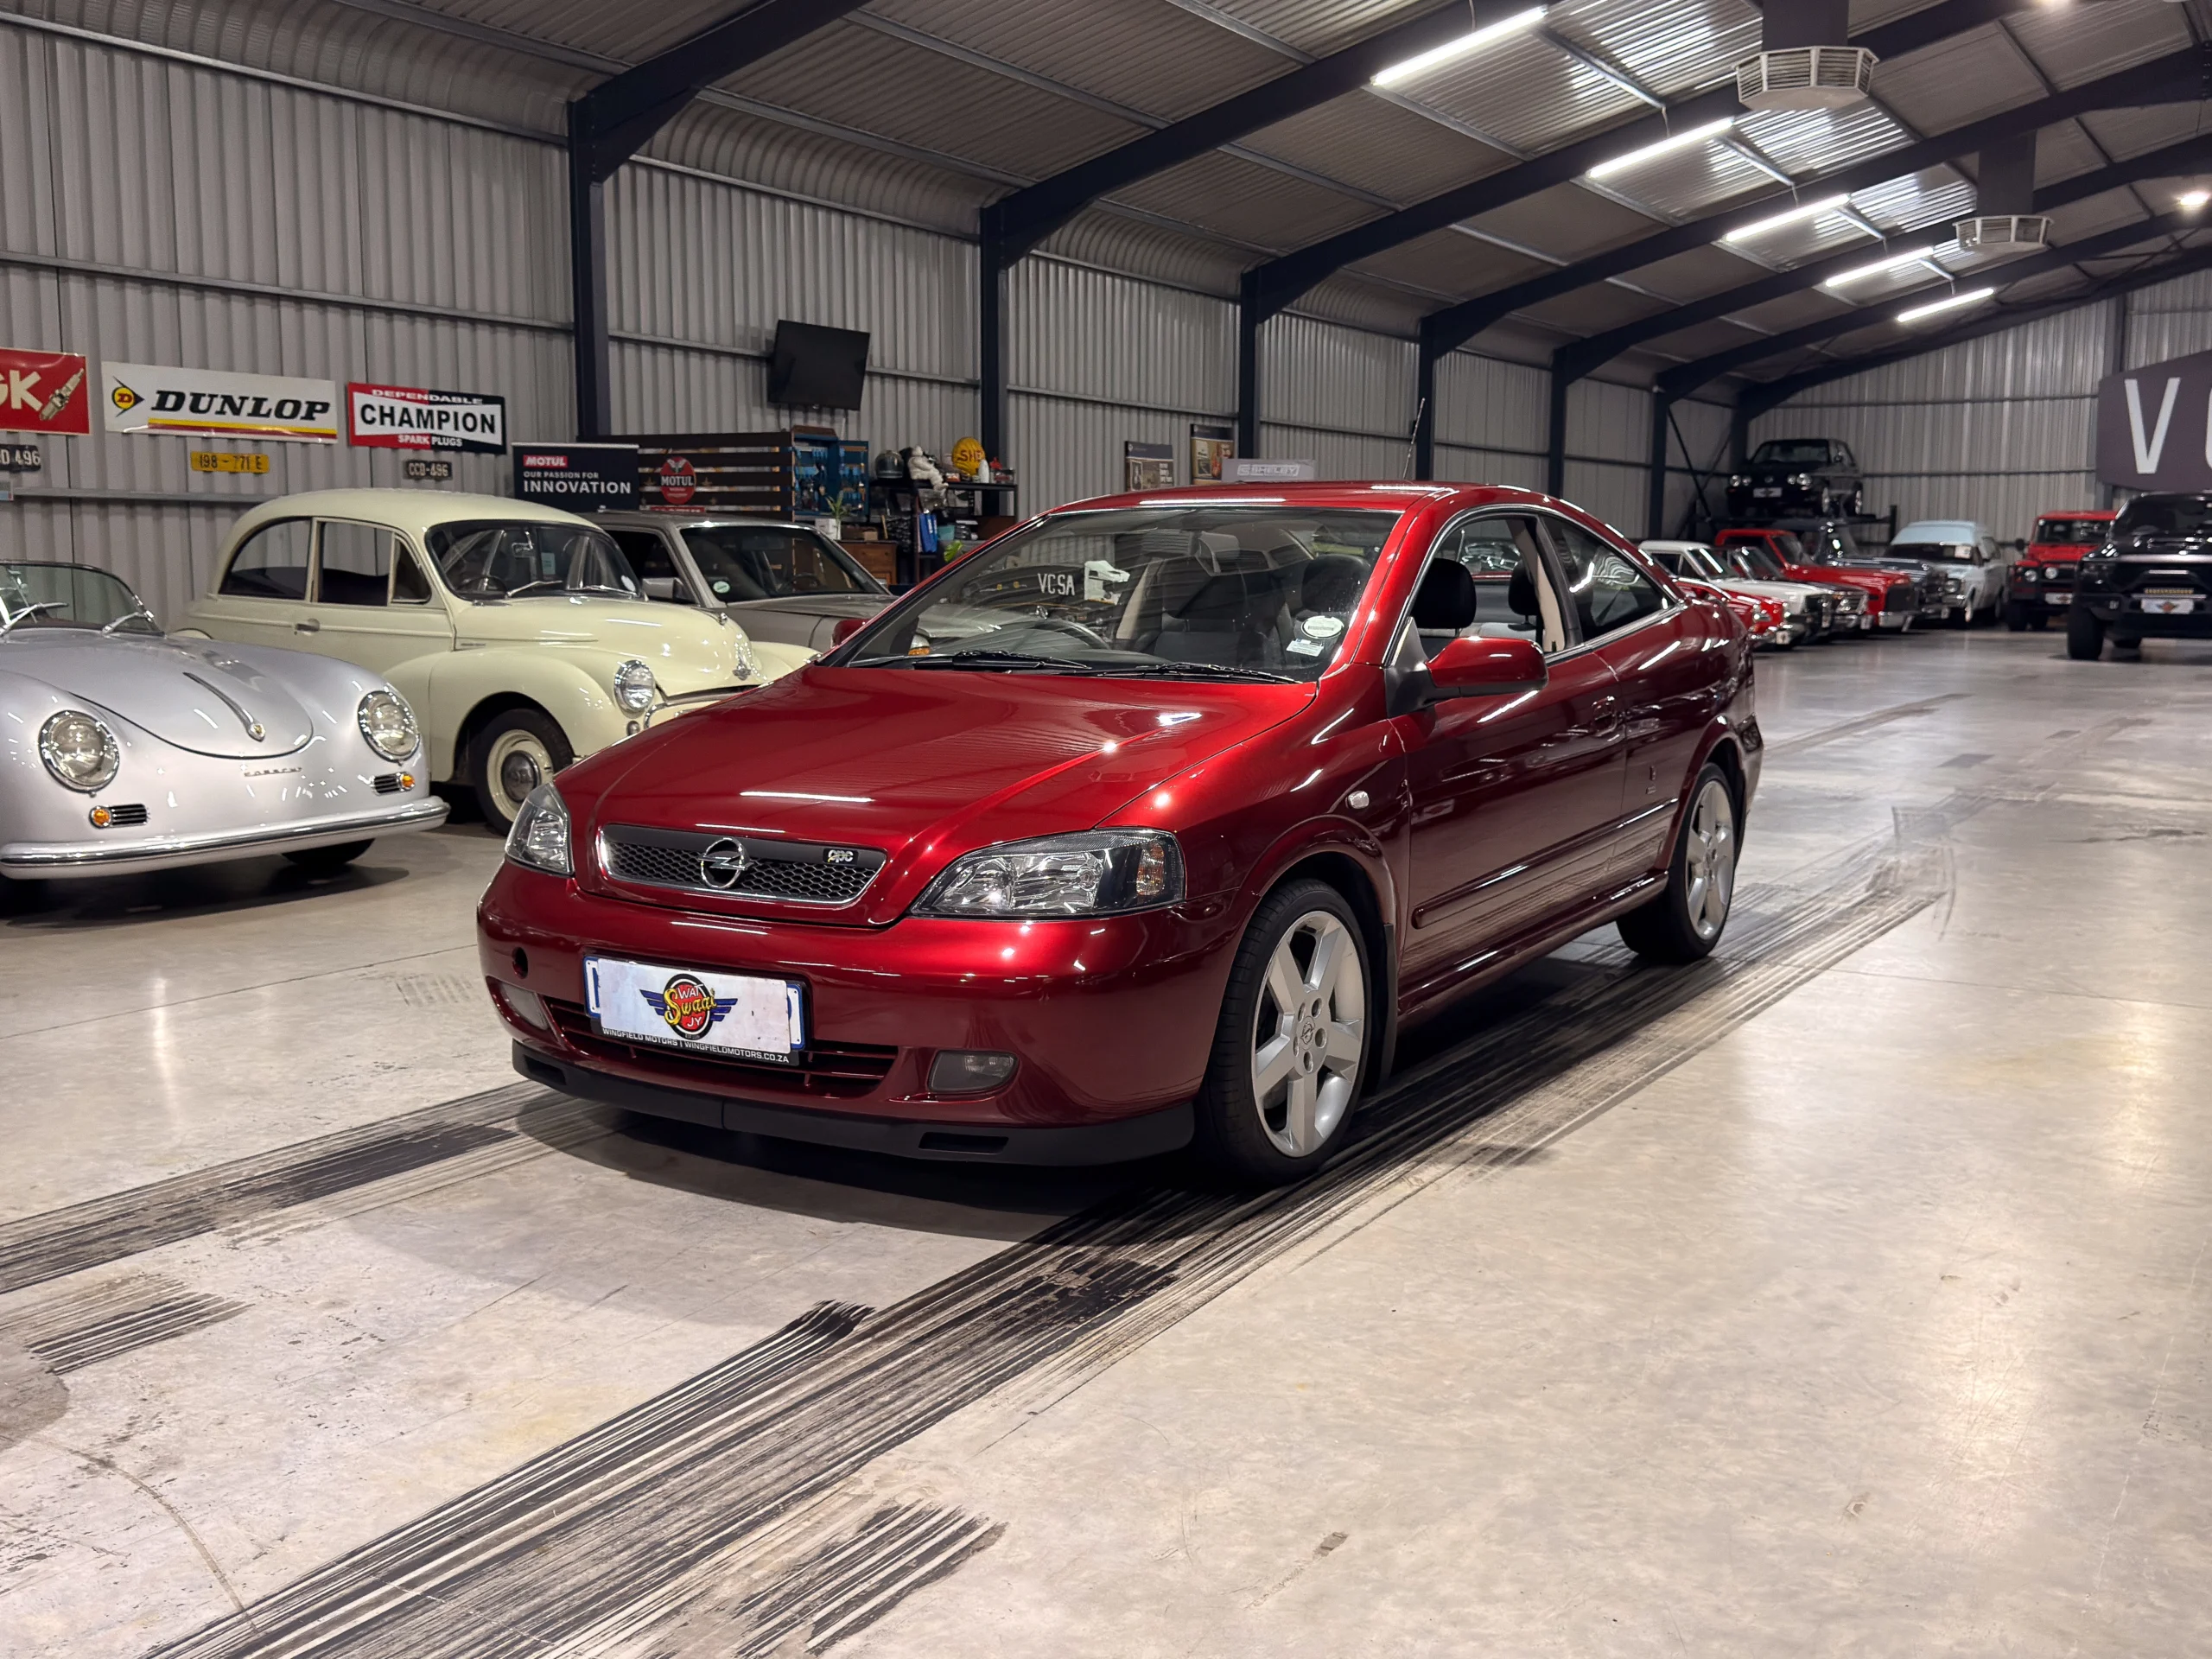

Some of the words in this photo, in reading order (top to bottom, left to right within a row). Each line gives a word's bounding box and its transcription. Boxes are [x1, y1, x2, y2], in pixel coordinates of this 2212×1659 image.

[372, 389, 483, 404] DEPENDABLE
[150, 390, 331, 421] DUNLOP
[360, 404, 496, 434] CHAMPION
[2124, 377, 2212, 474] V
[397, 435, 430, 445] SPARK
[431, 436, 463, 447] PLUGS
[200, 454, 218, 468] 198
[525, 455, 566, 467] MOTUL
[524, 480, 631, 494] INNOVATION
[661, 475, 695, 486] MOTUL
[1038, 573, 1075, 596] VCSA
[677, 983, 704, 1000] WAT
[687, 1016, 702, 1027] JY
[602, 1028, 644, 1040] WINGFIELD
[645, 1035, 678, 1046] MOTORS
[684, 1041, 790, 1064] WINGFIELDMOTORS.CO.ZA
